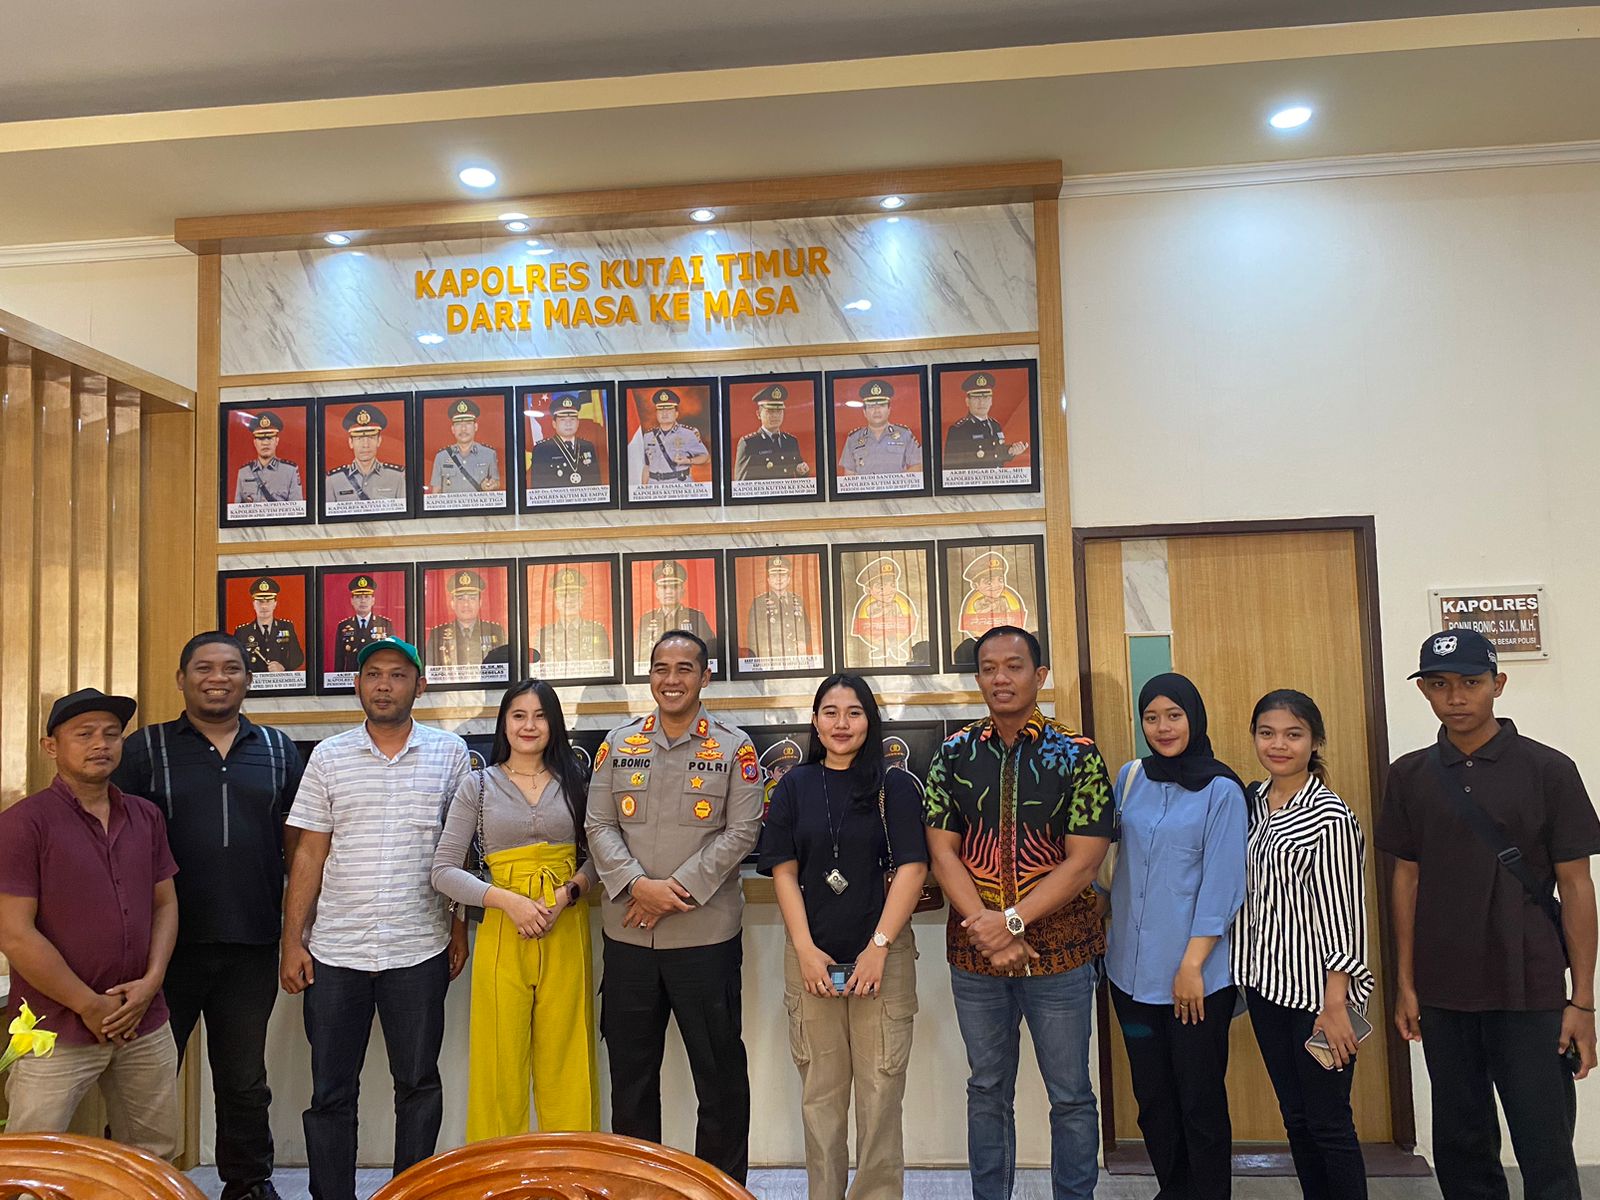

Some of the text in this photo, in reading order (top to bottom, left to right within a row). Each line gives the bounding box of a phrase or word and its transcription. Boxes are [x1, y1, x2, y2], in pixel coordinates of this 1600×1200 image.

[414, 246, 832, 299] KAPOLRES KUTAI TIMUR
[446, 285, 801, 333] DARI MASA KE MASA
[1442, 597, 1538, 613] KAPOLRES
[1473, 620, 1498, 634] BONIC,
[1520, 619, 1536, 632] M.H.
[1498, 638, 1518, 646] BESAR
[1518, 637, 1536, 645] POLISI
[612, 758, 650, 768] R.BONIC
[688, 762, 728, 772] POLRI
